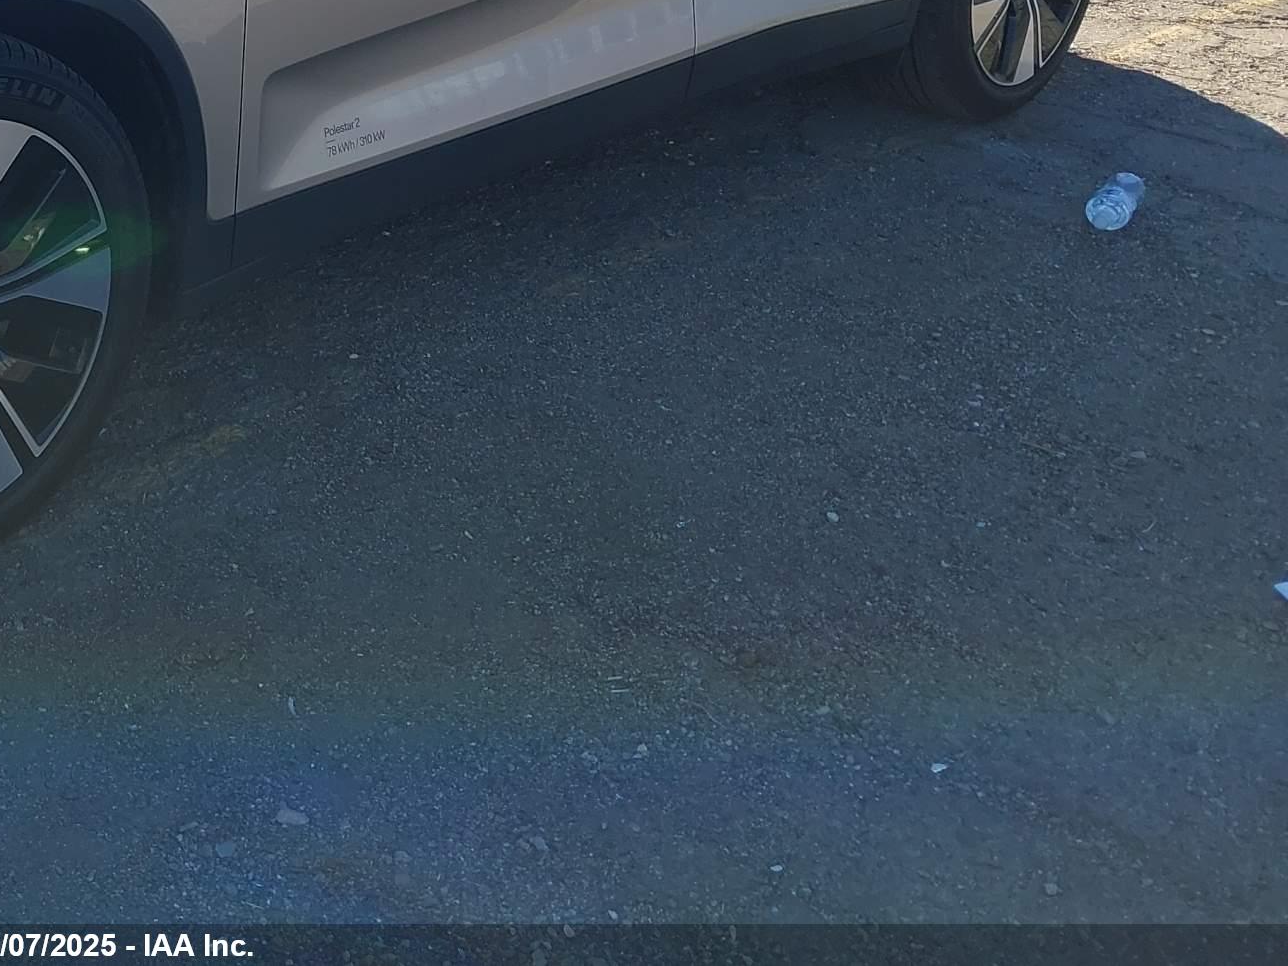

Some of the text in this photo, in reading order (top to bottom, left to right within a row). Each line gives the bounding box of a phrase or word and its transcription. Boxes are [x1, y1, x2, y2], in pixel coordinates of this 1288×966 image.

[324, 117, 360, 137] Polestar 2
[327, 146, 337, 157] 78
[338, 140, 355, 154] kWh
[360, 133, 372, 146] 310
